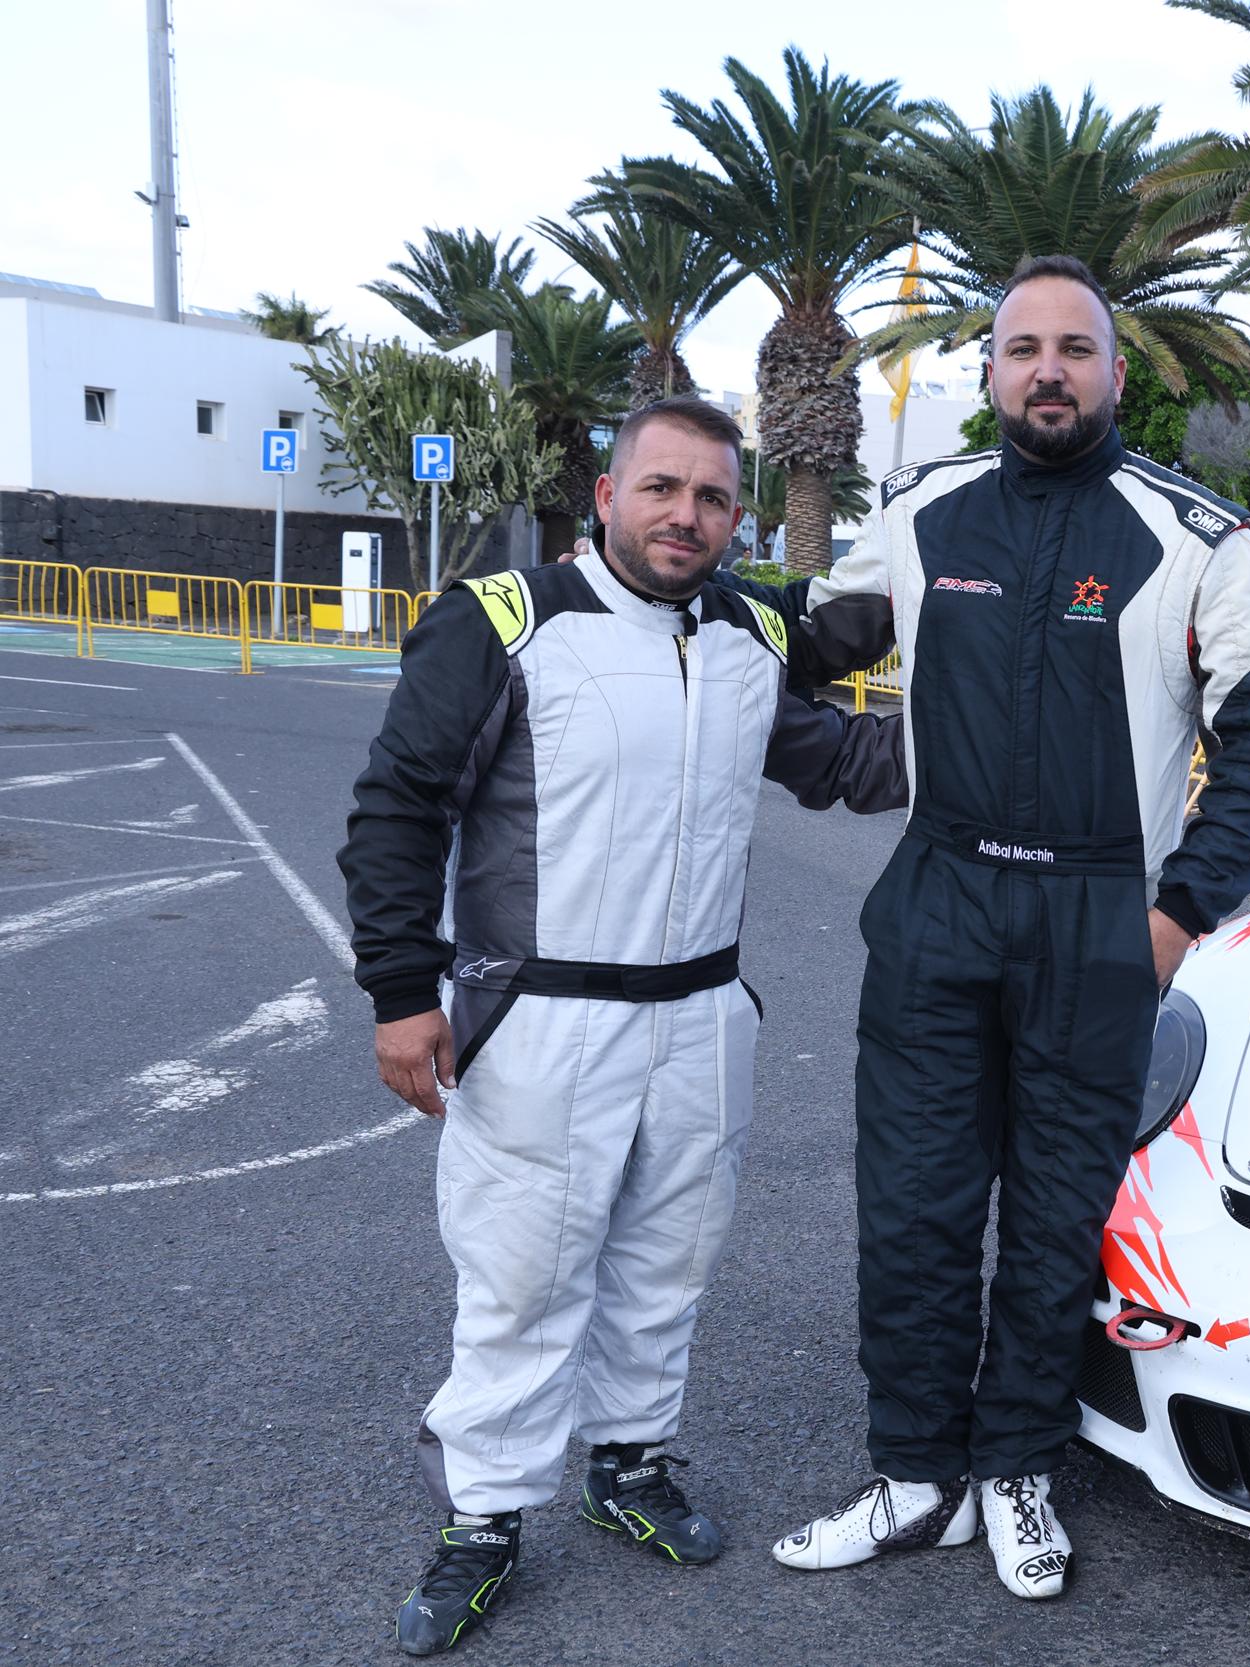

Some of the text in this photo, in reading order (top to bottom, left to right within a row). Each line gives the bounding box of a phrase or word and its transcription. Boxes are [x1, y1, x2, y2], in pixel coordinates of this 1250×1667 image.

[269, 436, 291, 467] P
[421, 443, 444, 475] P
[886, 471, 918, 493] OMP
[1187, 508, 1225, 533] OMP
[1023, 1553, 1068, 1578] OMP
